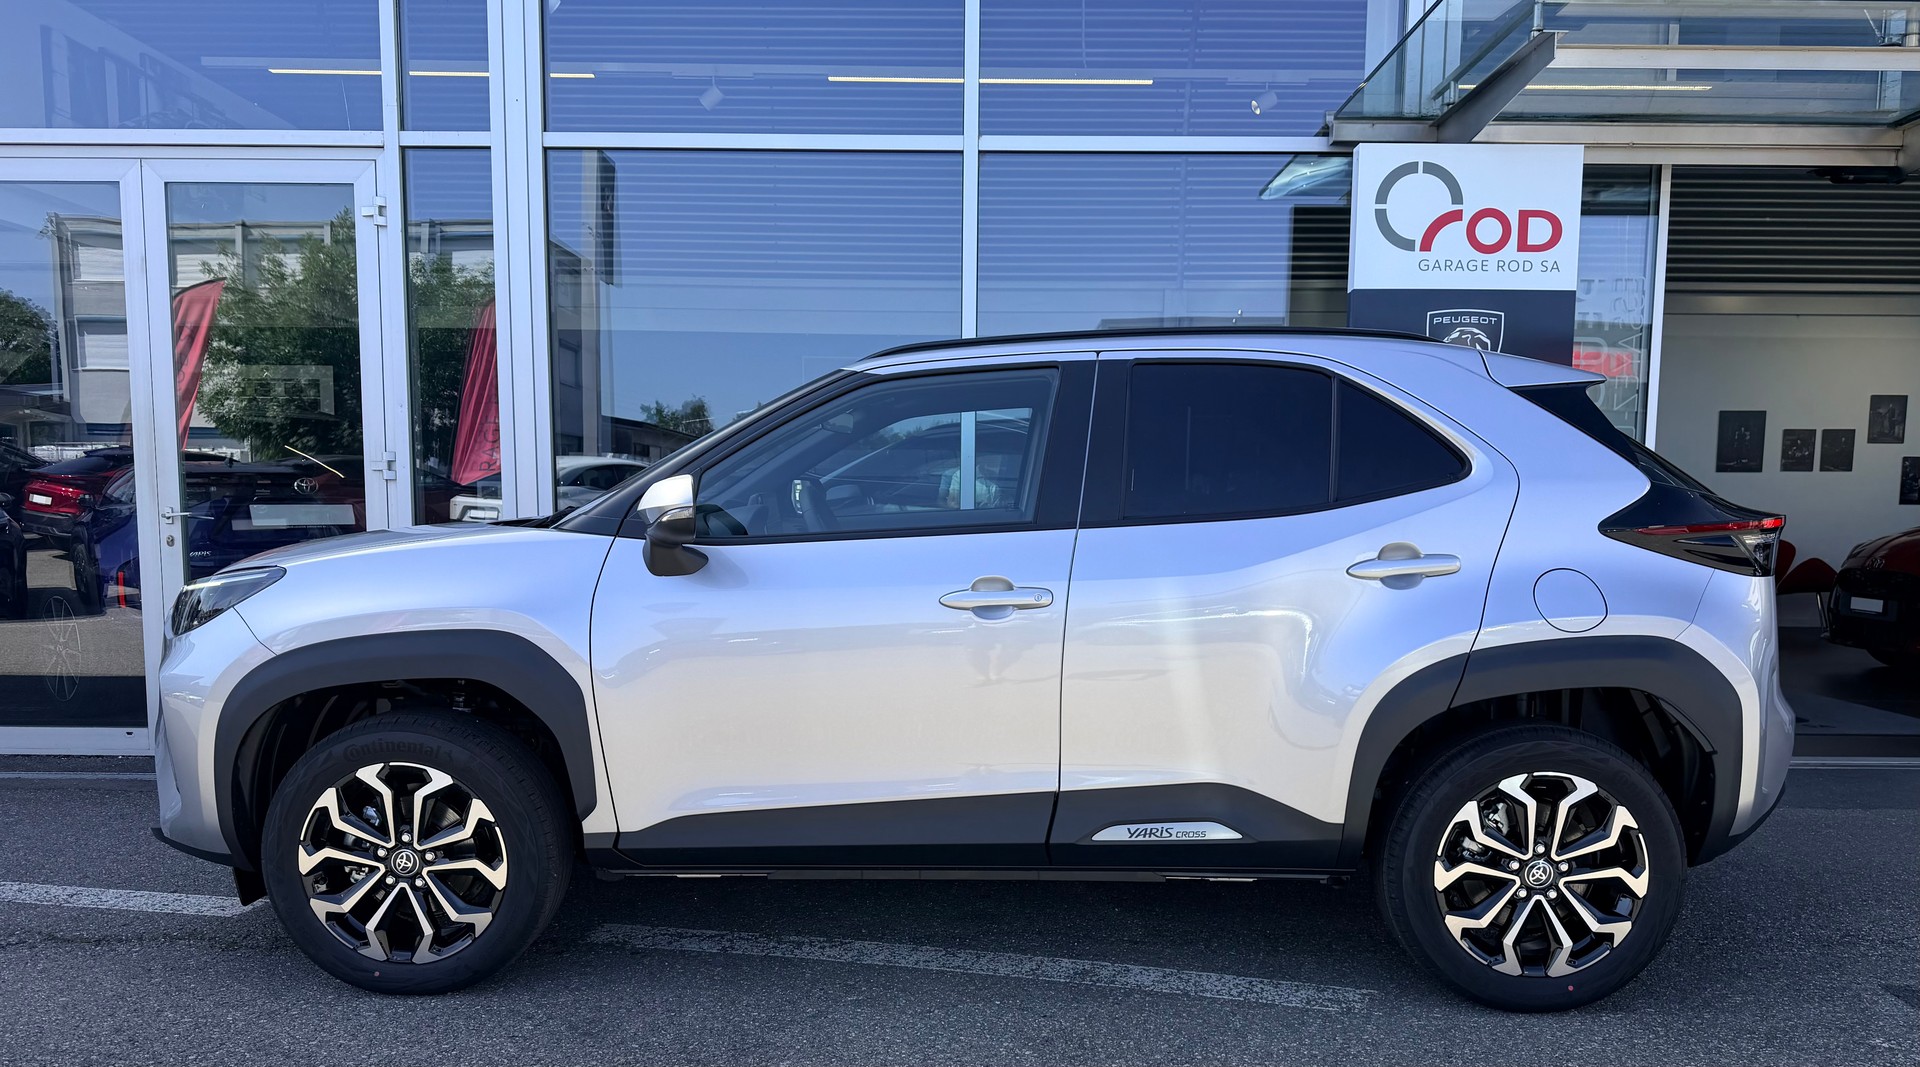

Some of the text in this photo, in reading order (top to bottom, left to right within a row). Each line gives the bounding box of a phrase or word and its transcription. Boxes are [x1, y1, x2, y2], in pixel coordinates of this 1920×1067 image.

[1418, 259, 1561, 273] GARAGE ROD SA
[1433, 315, 1498, 325] PEUGEOT
[343, 738, 442, 762] Continental
[1175, 830, 1207, 839] CROSS
